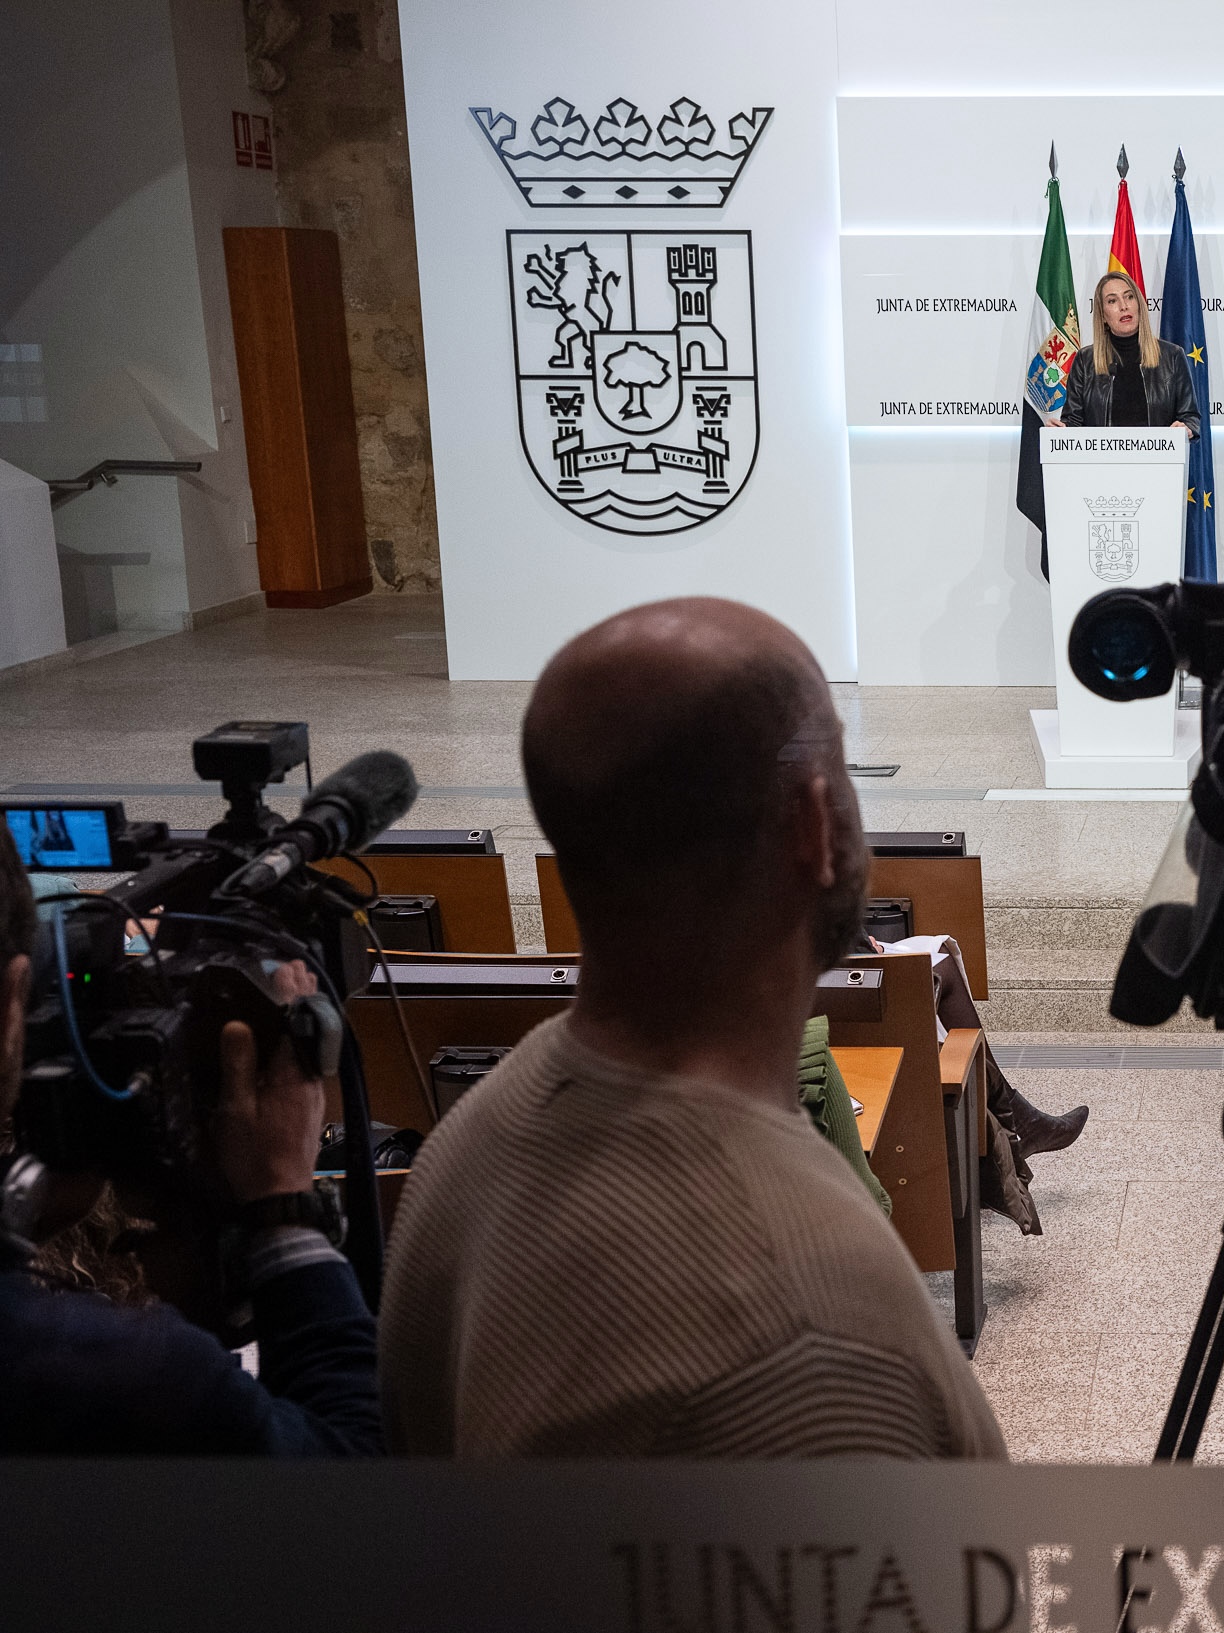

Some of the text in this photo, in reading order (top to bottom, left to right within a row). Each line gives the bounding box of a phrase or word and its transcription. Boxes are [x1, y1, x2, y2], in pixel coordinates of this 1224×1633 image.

[877, 299, 1017, 313] JUNTA DE EXTREMADURA
[880, 401, 1019, 416] JUNTA DE EXTREMADURA
[1051, 439, 1175, 452] JUNTA DE EXTREMADURA
[585, 452, 702, 466] PLUS ULTRA
[611, 1544, 930, 1633] JUNTA
[962, 1544, 1074, 1633] DE
